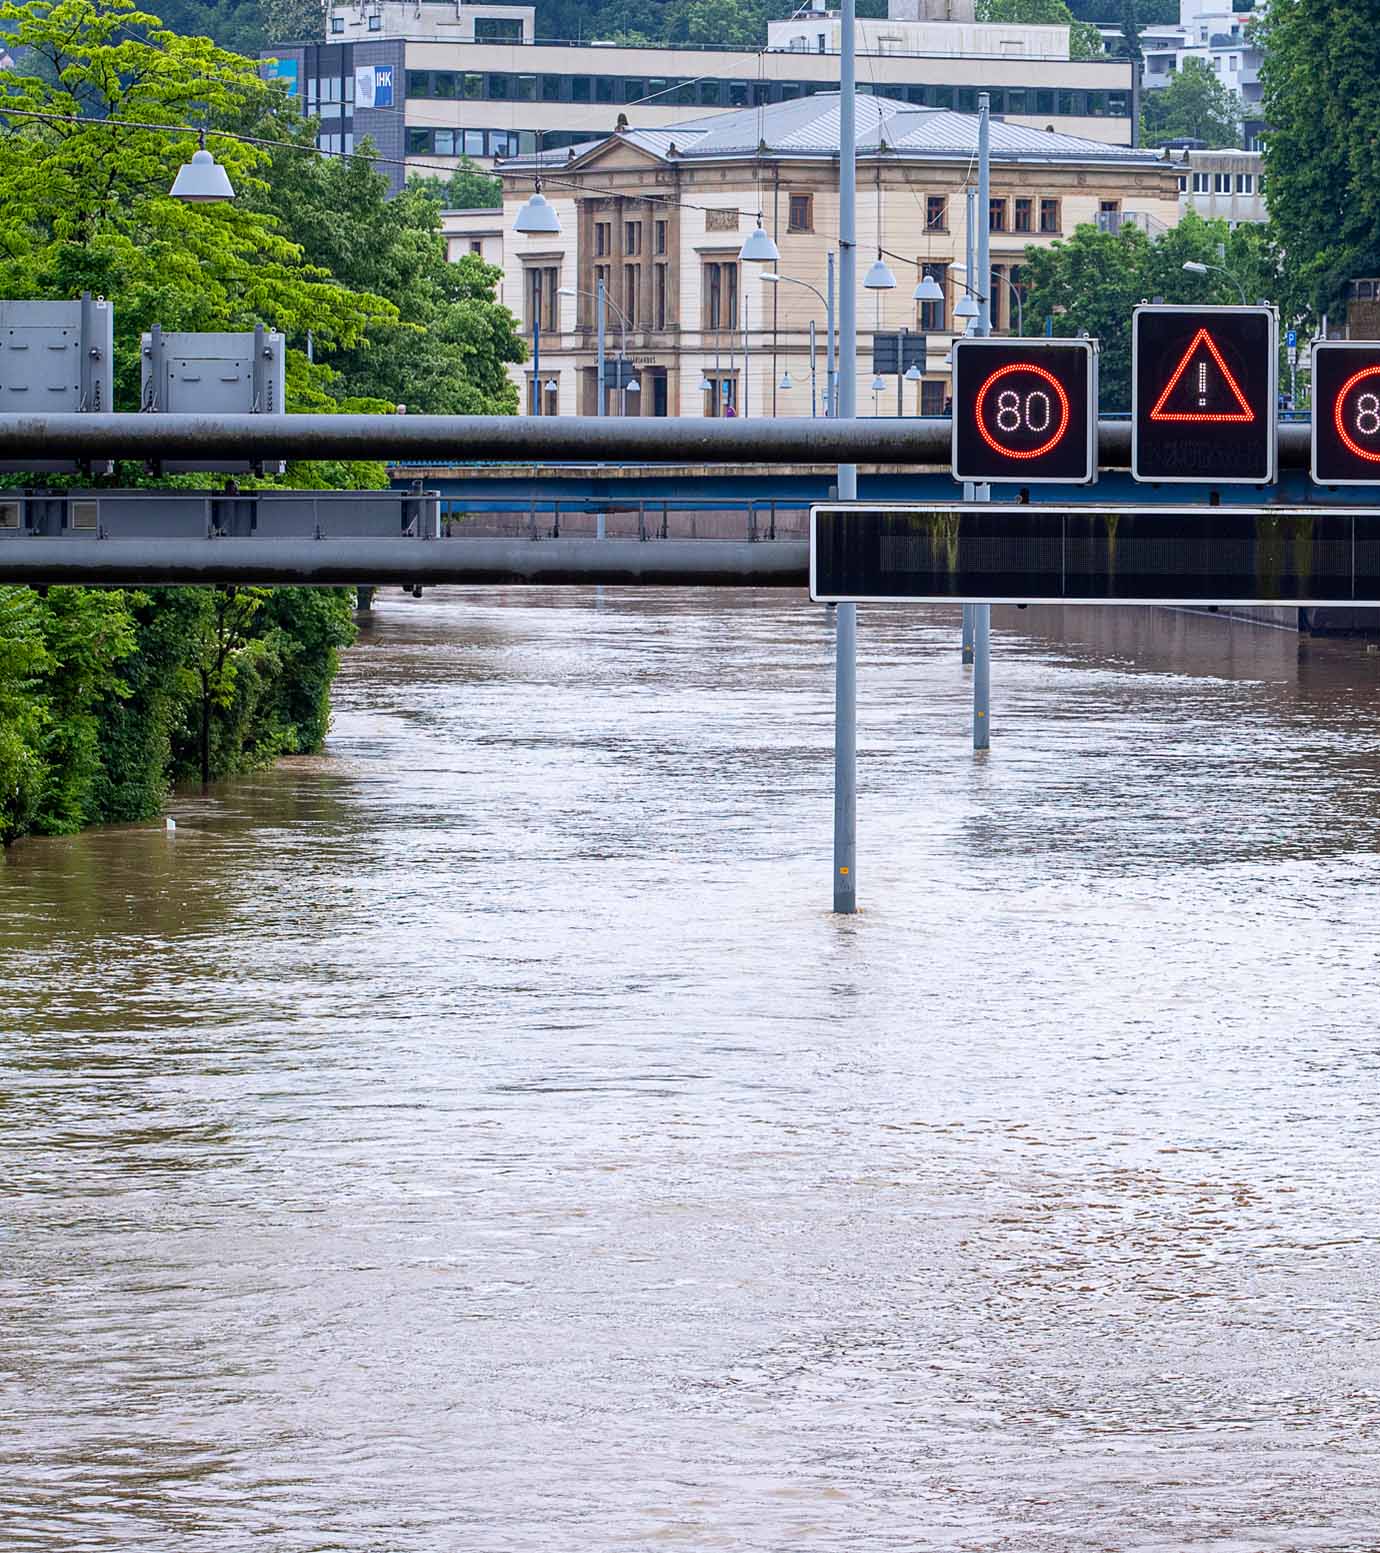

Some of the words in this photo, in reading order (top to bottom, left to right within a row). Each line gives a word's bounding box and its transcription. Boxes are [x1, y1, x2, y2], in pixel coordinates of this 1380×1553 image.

[376, 71, 392, 87] IHK
[1288, 332, 1294, 345] P
[997, 391, 1050, 432] 80
